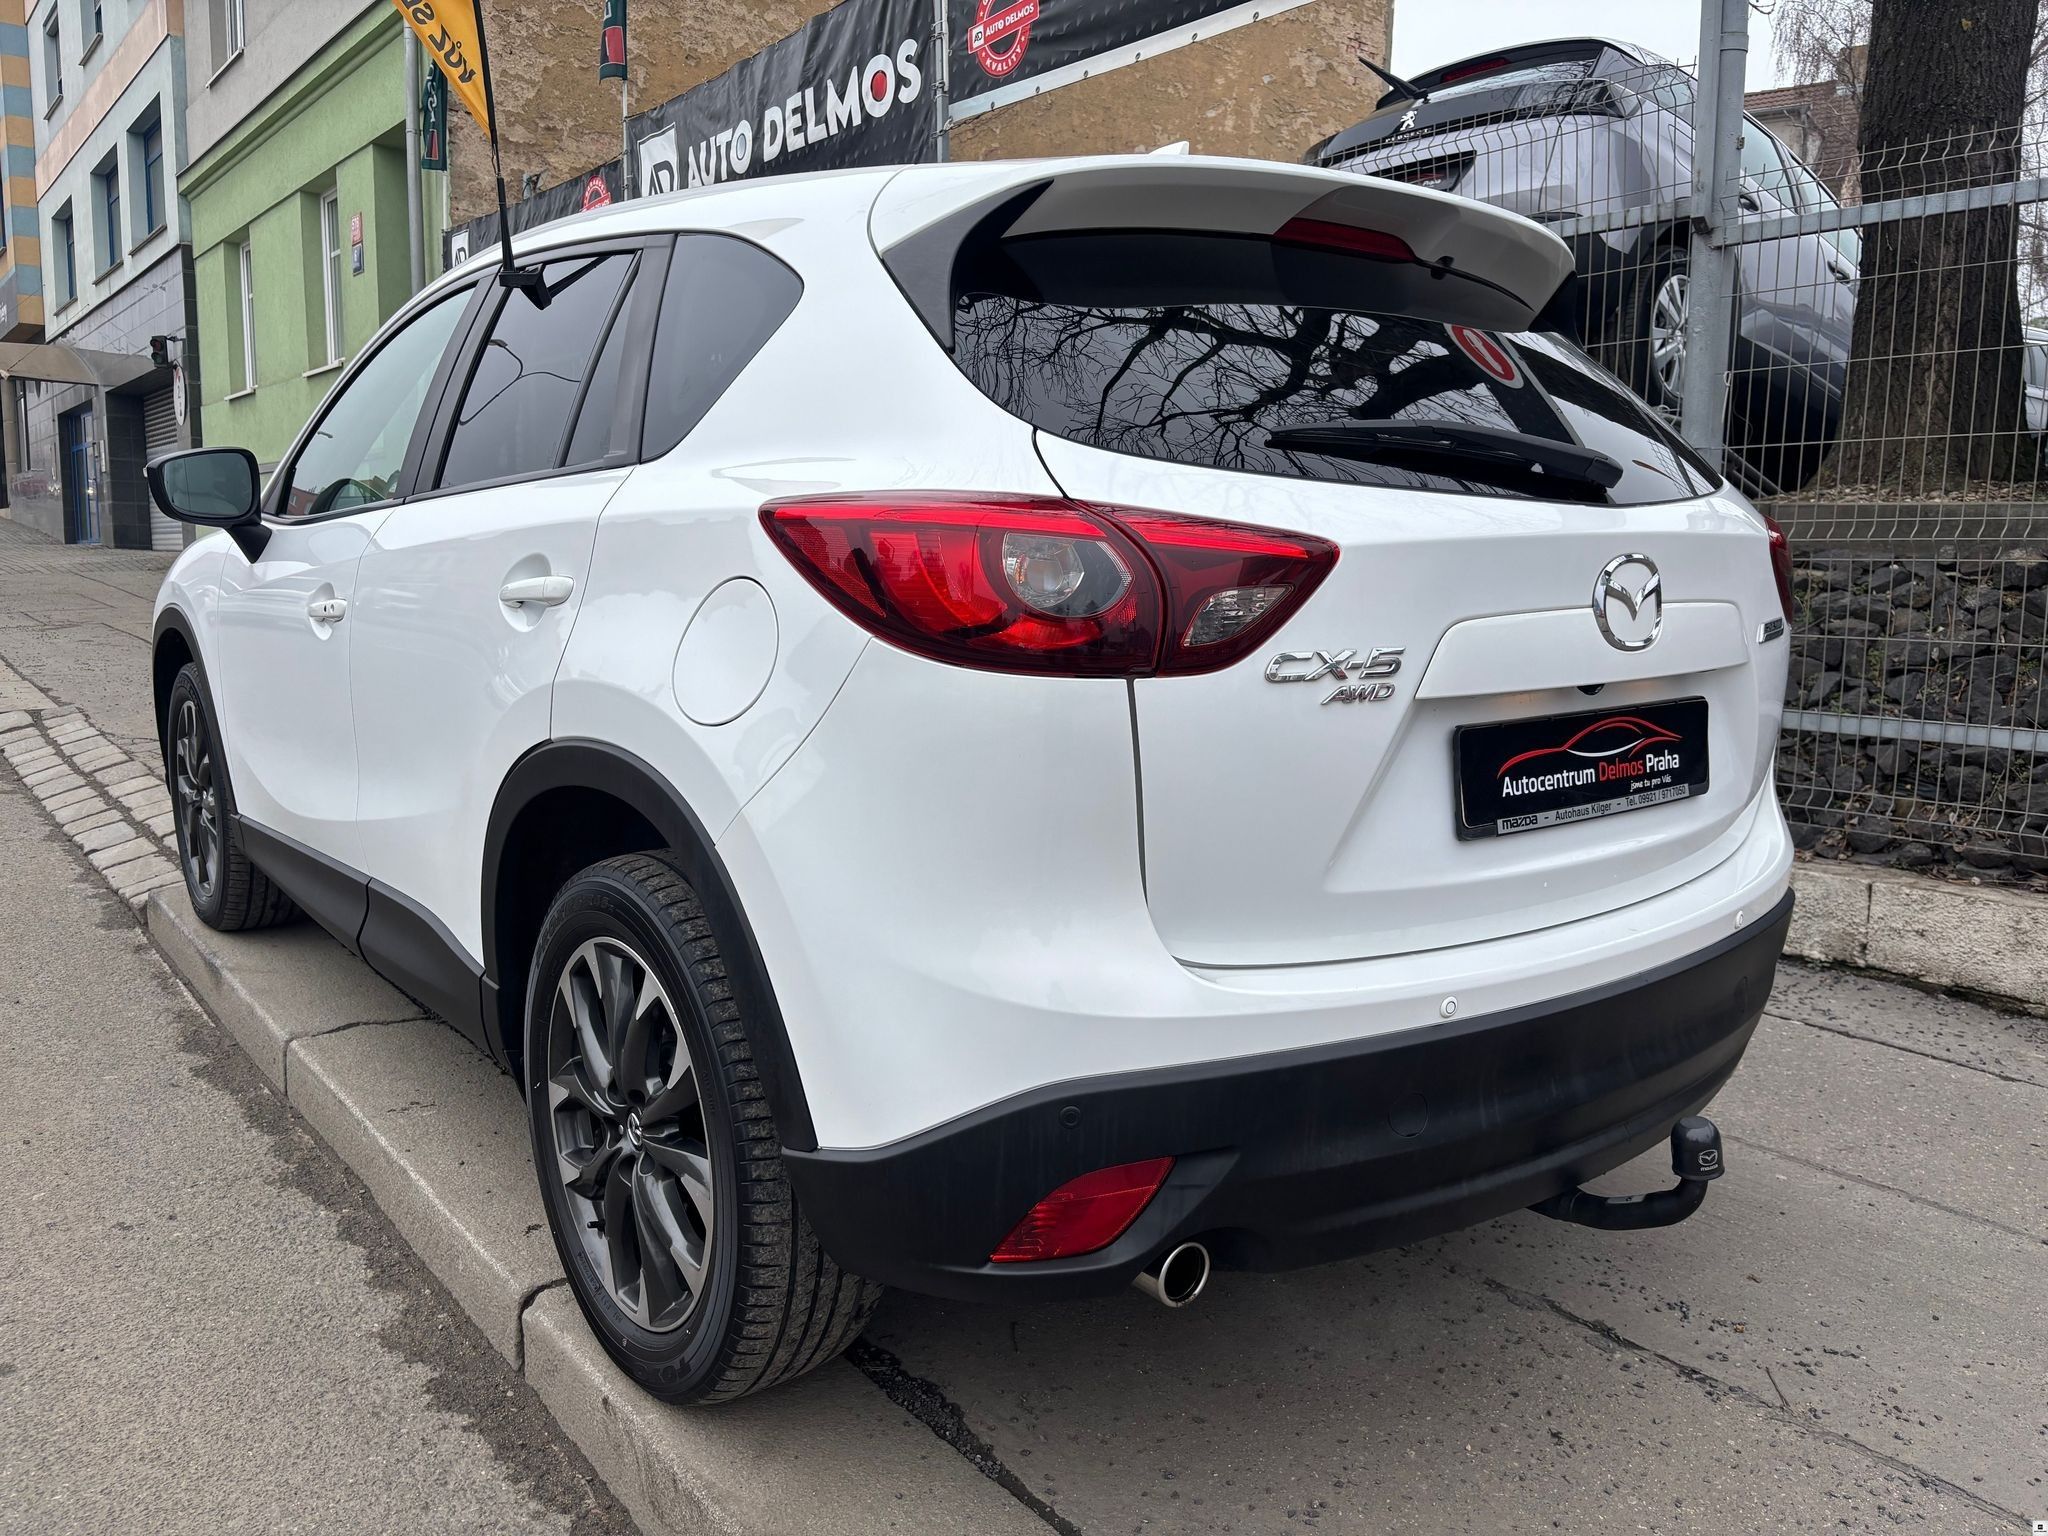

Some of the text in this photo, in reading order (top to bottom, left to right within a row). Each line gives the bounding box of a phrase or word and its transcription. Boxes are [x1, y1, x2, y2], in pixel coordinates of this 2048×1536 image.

[985, 19, 1004, 37] AUTO
[1005, 3, 1034, 26] DELMOS
[986, 45, 1021, 71] KVALITY
[687, 119, 753, 189] AUTO
[763, 38, 922, 163] DELMOS
[1264, 647, 1406, 683] CX-5
[1320, 682, 1396, 706] AWD
[1502, 750, 1680, 798] Autocentrum Delmos Praha
[1630, 780, 1644, 792] jsme
[1644, 779, 1651, 787] tu
[1651, 778, 1661, 788] pro
[1555, 806, 1590, 821] Autohaus
[1591, 802, 1612, 815] Kilger
[1625, 796, 1637, 807] Tel.
